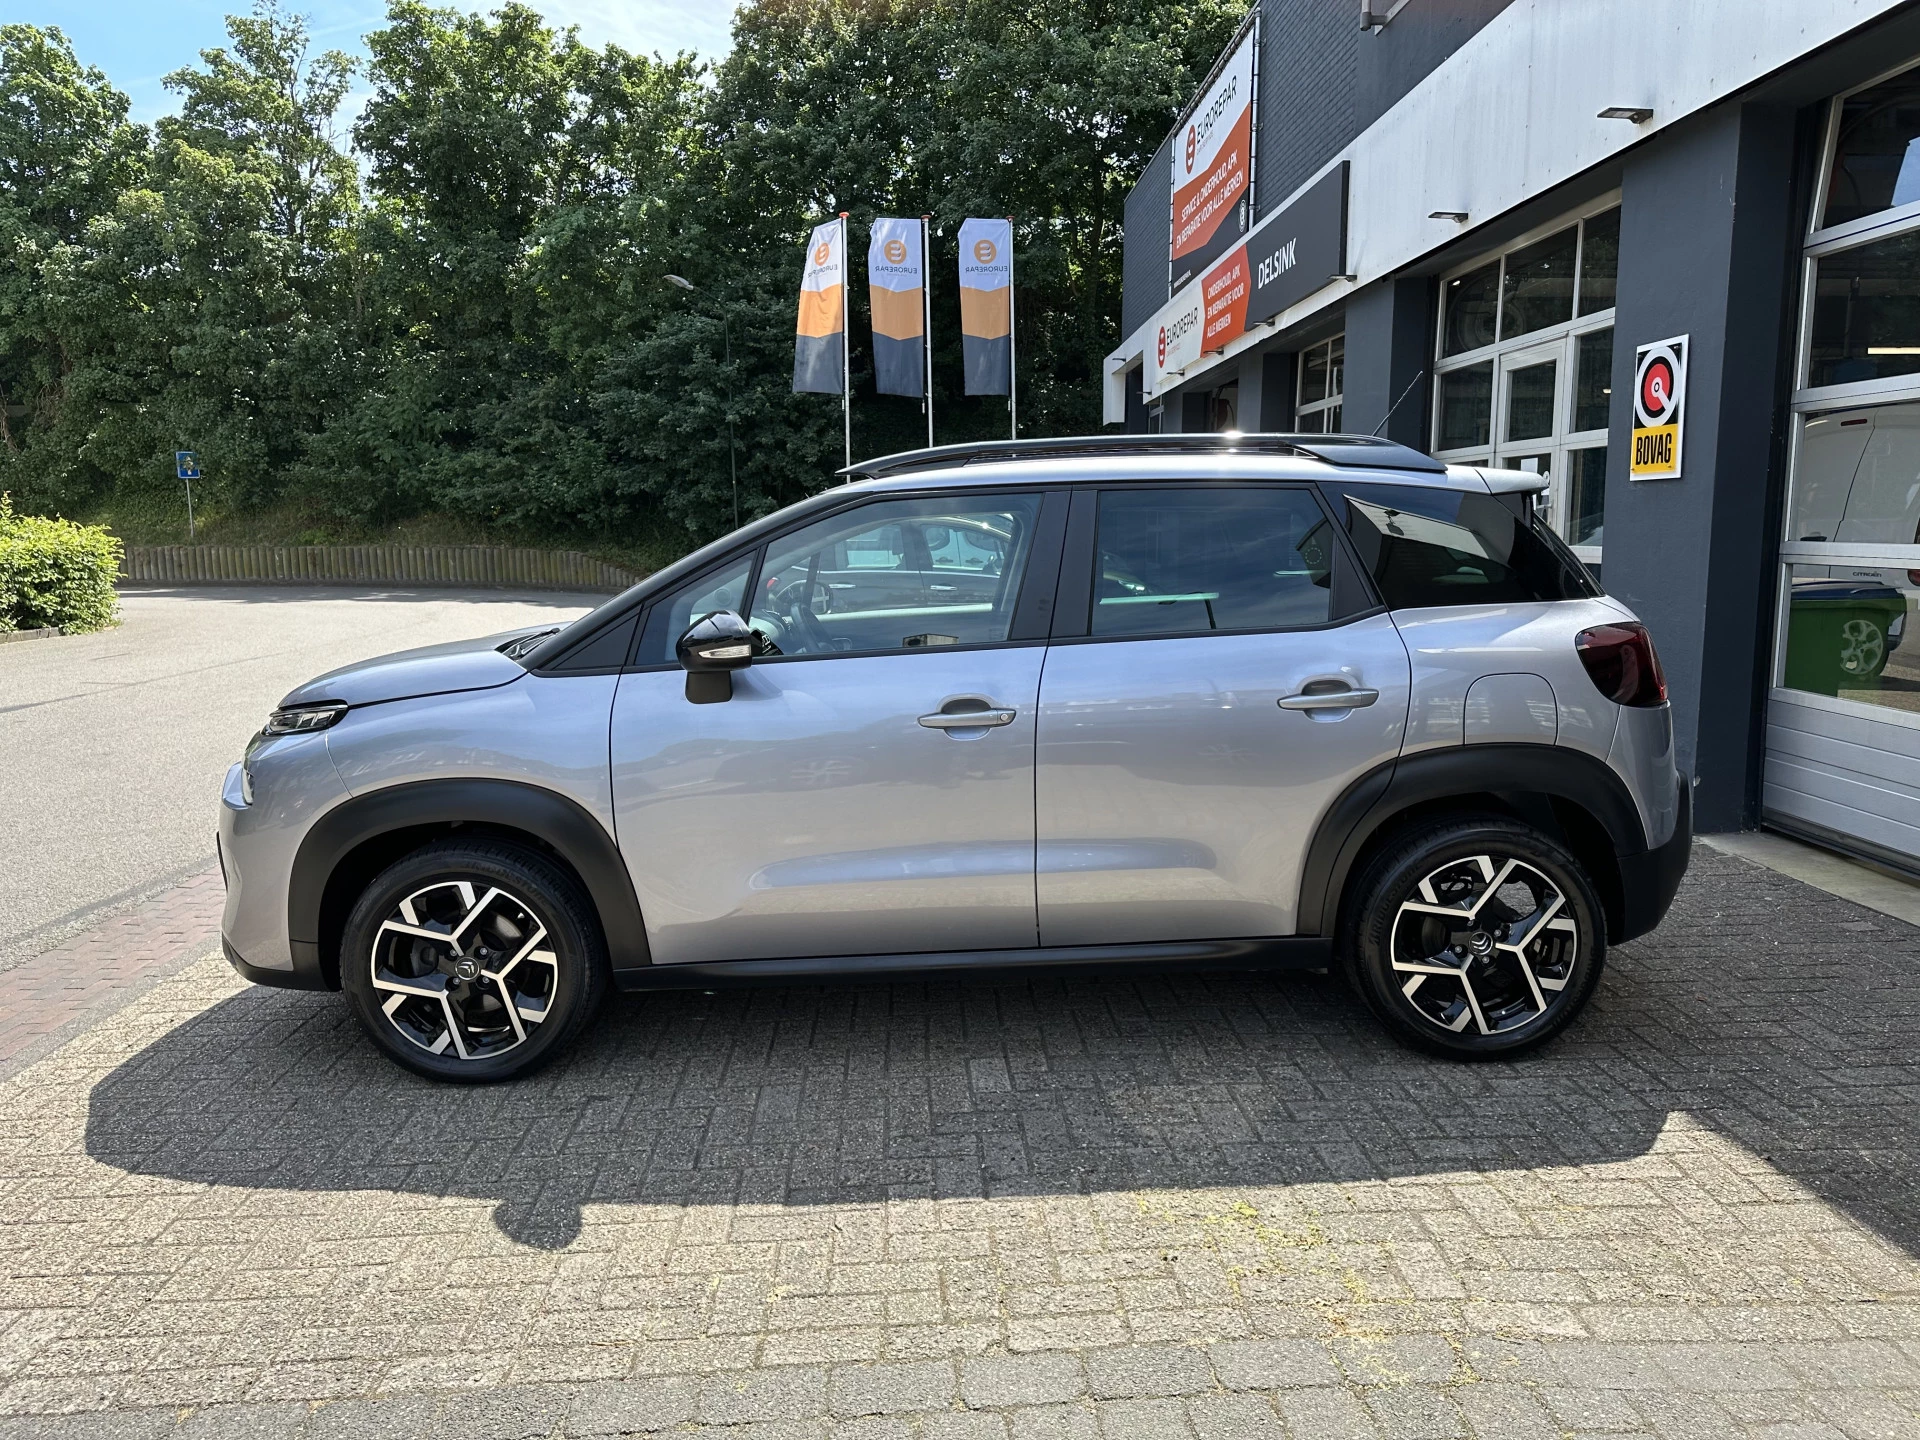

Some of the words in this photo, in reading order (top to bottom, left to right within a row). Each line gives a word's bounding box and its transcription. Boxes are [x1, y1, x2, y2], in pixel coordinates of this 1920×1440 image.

[1196, 75, 1237, 144] EUROREPAR
[1181, 195, 1196, 223] SERVICE
[1227, 148, 1238, 172] APK
[1181, 212, 1201, 245] REPARATIE
[1200, 201, 1213, 224] VOOR
[1212, 188, 1224, 212] ALLE
[1223, 167, 1244, 201] MERKEN
[1231, 263, 1241, 281] APK
[1258, 237, 1297, 289] DELSINK
[1207, 306, 1213, 320] EN
[1212, 292, 1232, 316] REPARATIE
[1231, 282, 1244, 303] VOOR
[1166, 306, 1199, 347] EUROREPAR
[1207, 323, 1216, 339] ALLE
[1215, 312, 1232, 334] MERKEN
[1635, 432, 1672, 466] BOVAG
